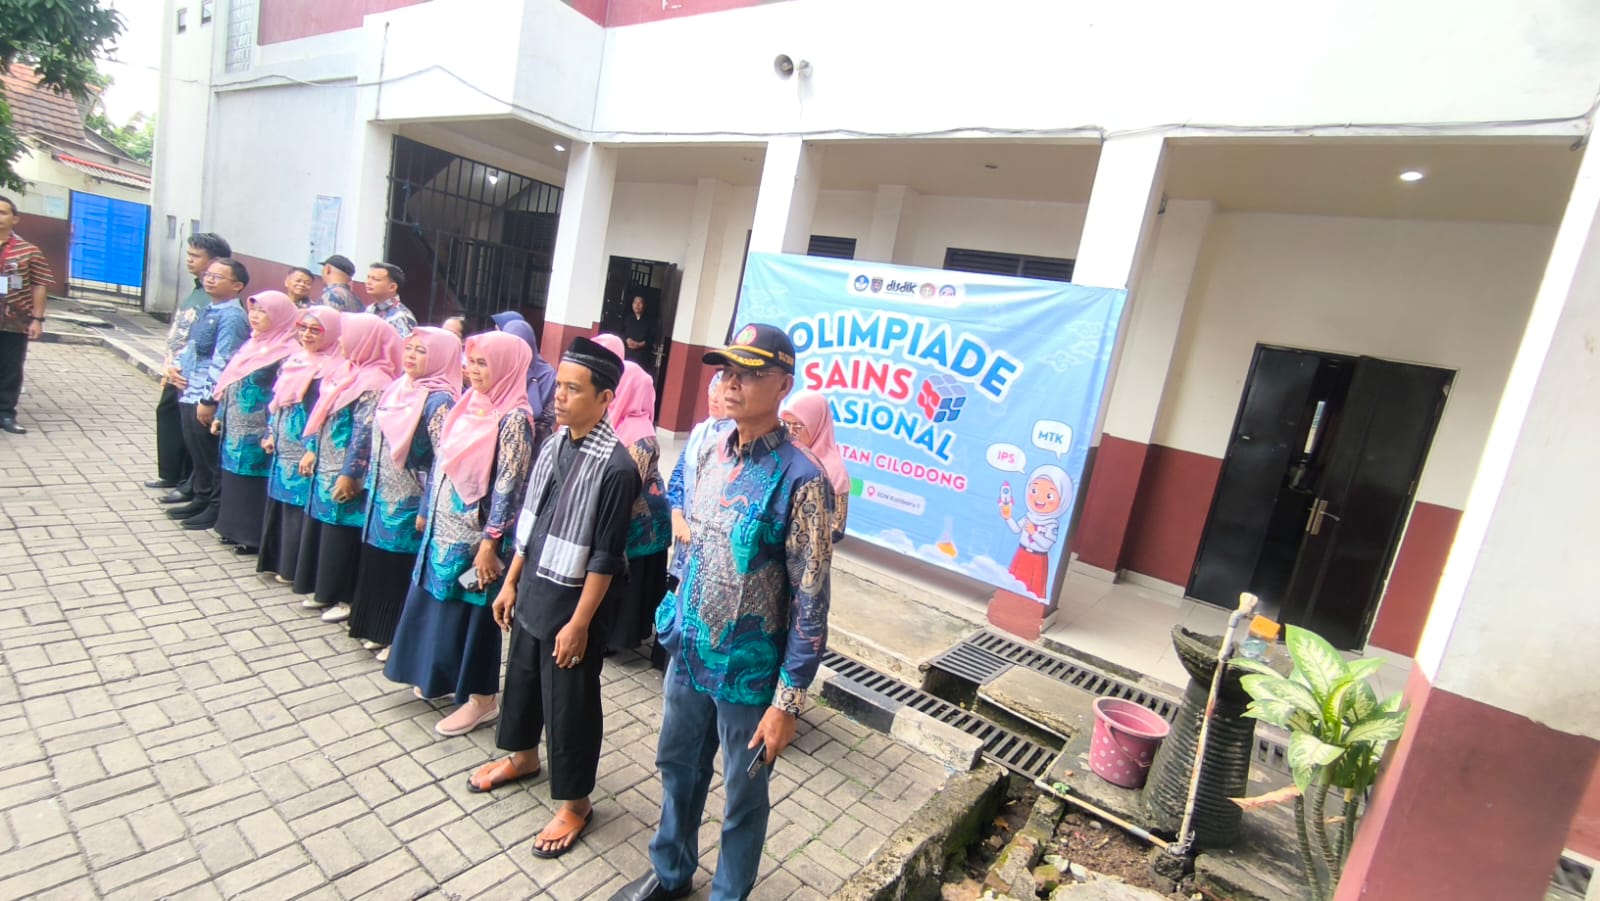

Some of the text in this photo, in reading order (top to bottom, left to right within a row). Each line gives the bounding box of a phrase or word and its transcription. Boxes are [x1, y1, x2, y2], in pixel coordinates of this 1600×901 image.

[788, 315, 1018, 398] OLIMPIADE
[805, 360, 913, 400] SAINS
[1038, 430, 1064, 444] MTK
[875, 454, 967, 490] CILODONG
[997, 450, 1016, 464] IPS
